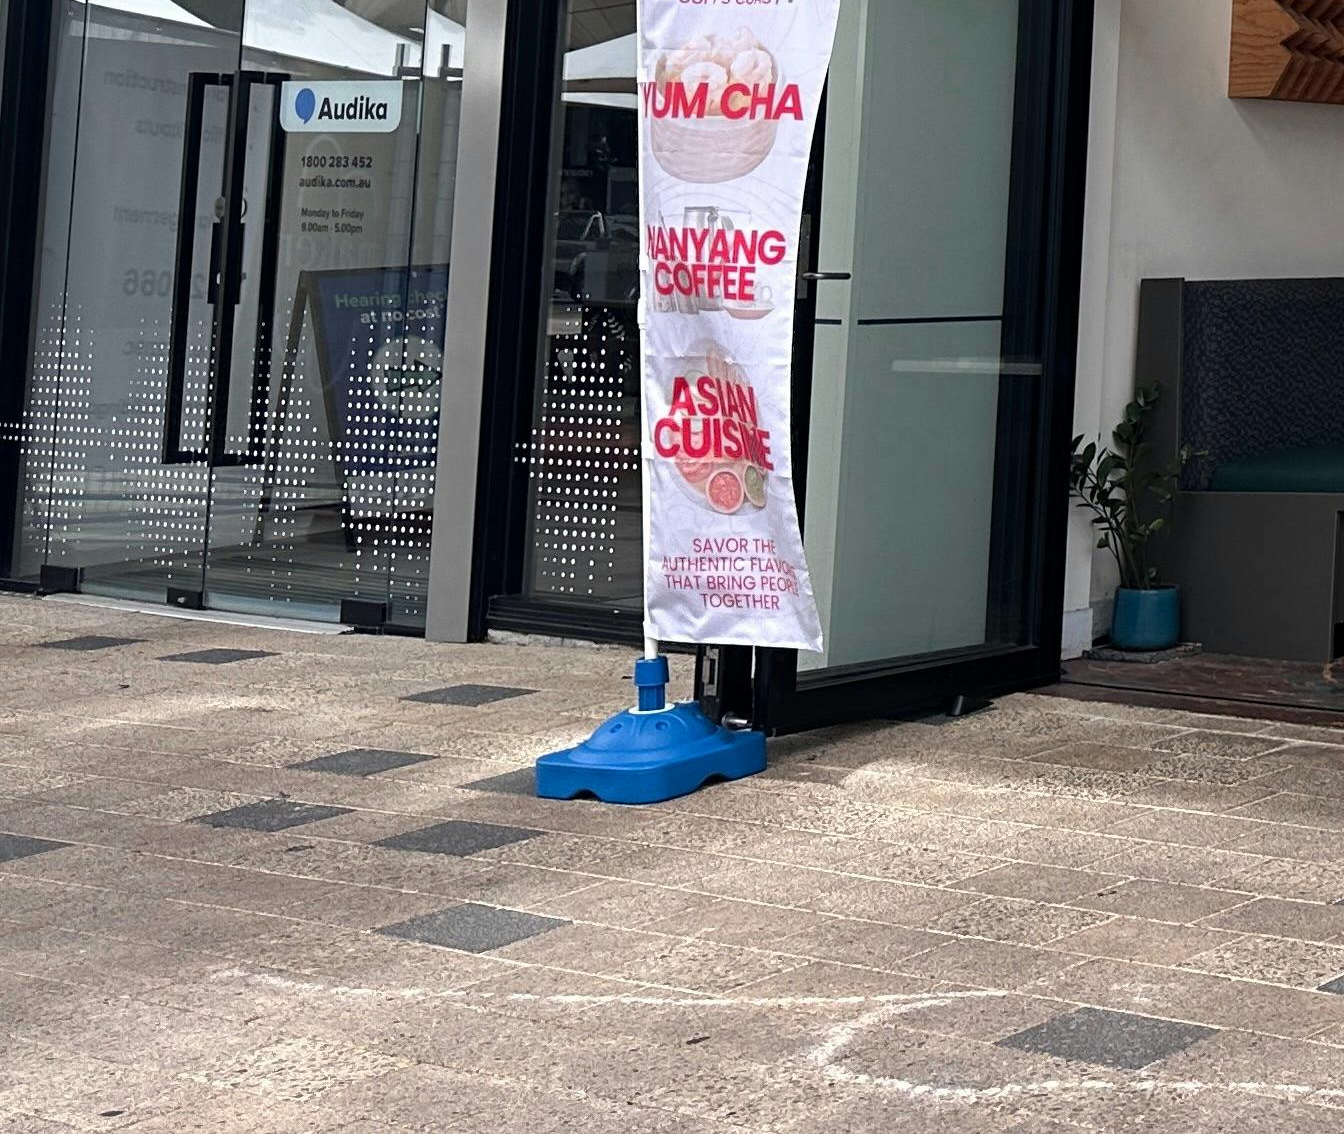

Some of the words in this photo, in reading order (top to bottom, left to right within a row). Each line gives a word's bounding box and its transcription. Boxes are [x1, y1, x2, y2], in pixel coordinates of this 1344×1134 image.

[318, 95, 388, 120] Audika
[640, 81, 709, 119] YUM
[720, 82, 804, 121] CHA
[301, 155, 327, 168] 1800
[328, 155, 350, 168] 283
[351, 155, 373, 168] 452
[299, 174, 371, 188] audika.com.au
[301, 208, 331, 220] Monday
[331, 209, 340, 219] to
[647, 224, 787, 265] NANYANG
[654, 262, 756, 301] COFFEE
[335, 292, 401, 308] Hearing
[360, 310, 379, 324] at
[381, 310, 403, 323] no
[668, 375, 758, 428] ASIAN
[693, 537, 748, 554] SAVOR
[752, 538, 776, 555] THE
[661, 556, 745, 572] AUTHENTIC
[664, 574, 702, 590] THAT
[706, 575, 756, 591] BRING
[700, 593, 780, 610] TOGETHER
